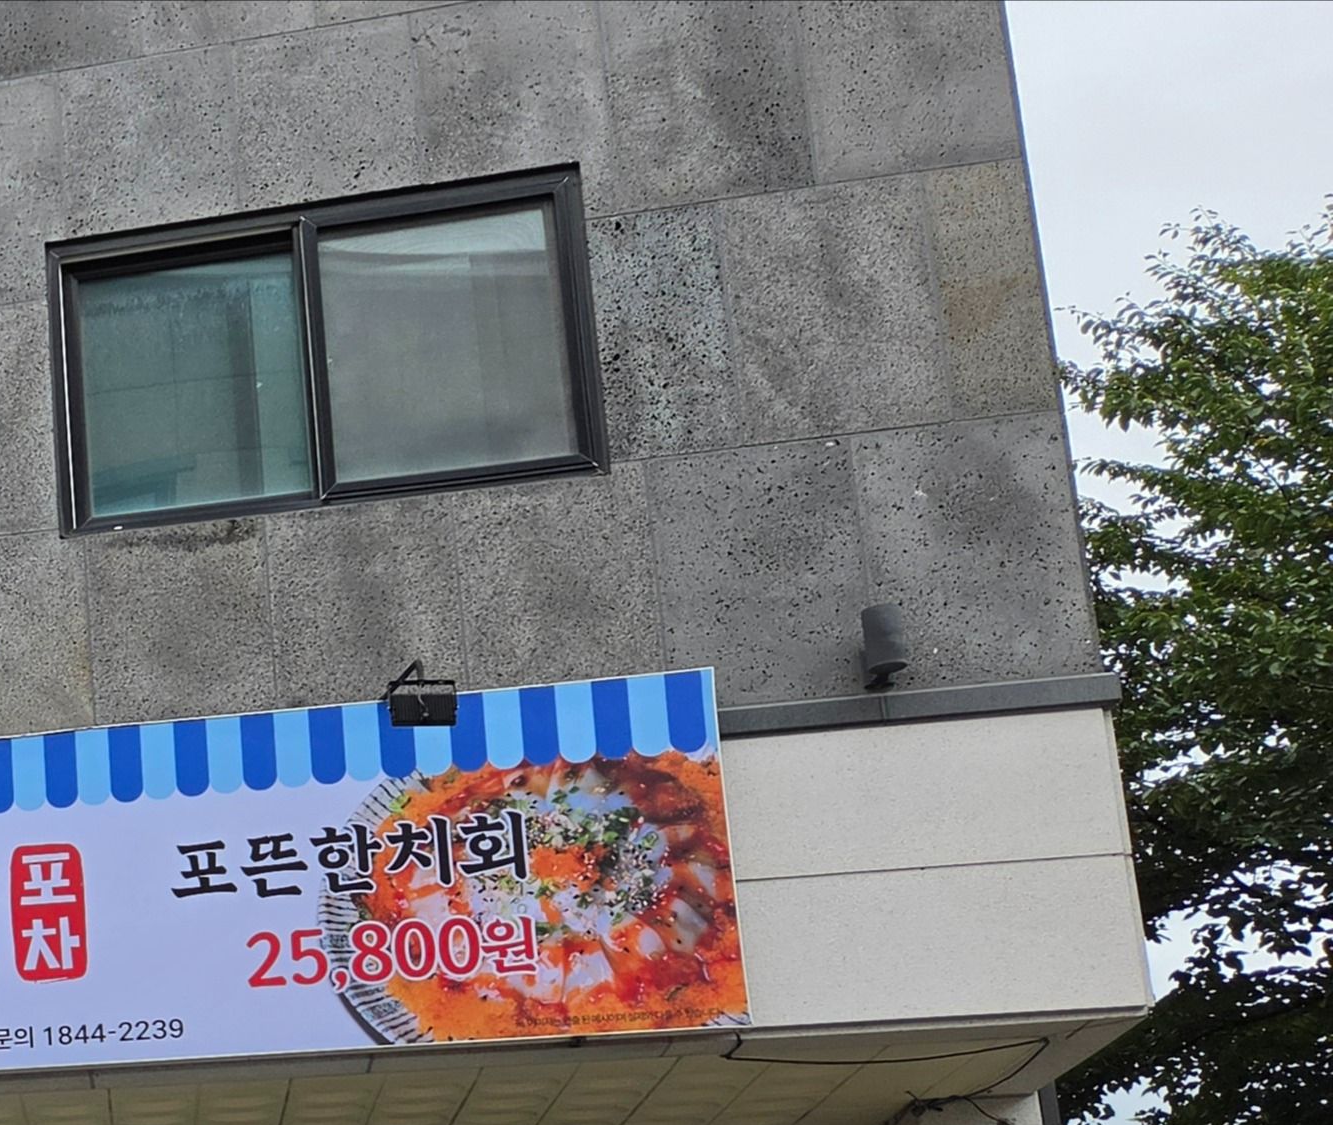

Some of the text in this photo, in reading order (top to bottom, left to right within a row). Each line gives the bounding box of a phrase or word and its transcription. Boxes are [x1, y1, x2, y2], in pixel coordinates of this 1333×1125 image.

[171, 810, 527, 899] 포뜬한치회
[246, 916, 537, 992] 25,800원
[42, 1019, 185, 1047] 1844-2239
